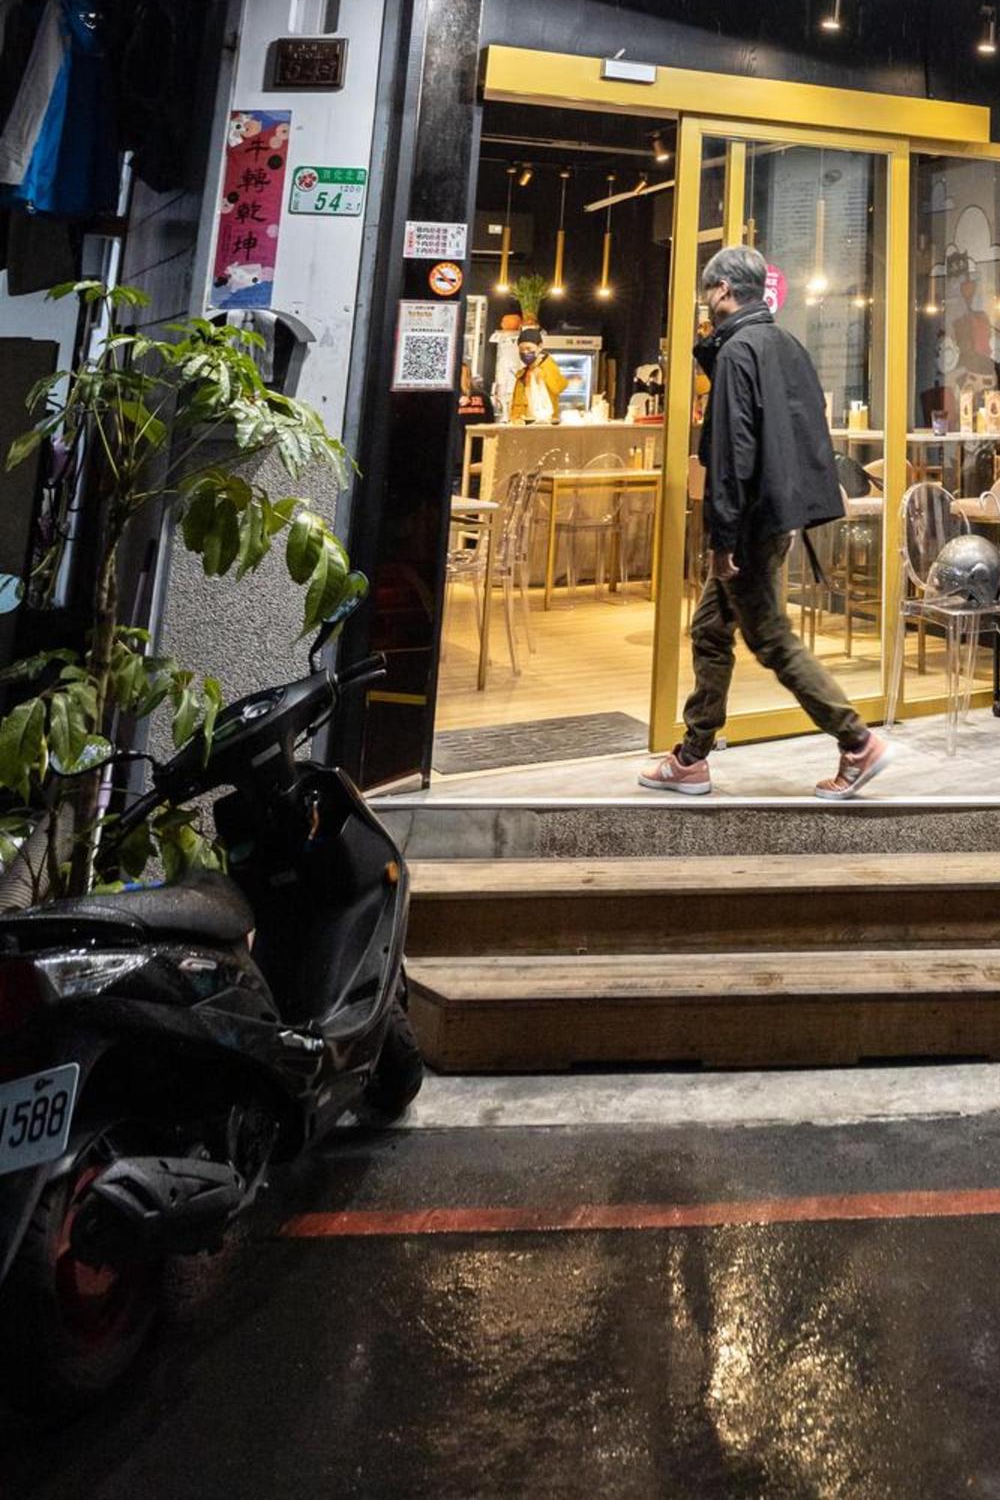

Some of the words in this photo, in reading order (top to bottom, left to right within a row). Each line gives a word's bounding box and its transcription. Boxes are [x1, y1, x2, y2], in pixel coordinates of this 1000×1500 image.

[233, 140, 271, 261] 牛轉乾坤
[314, 191, 343, 212] 54
